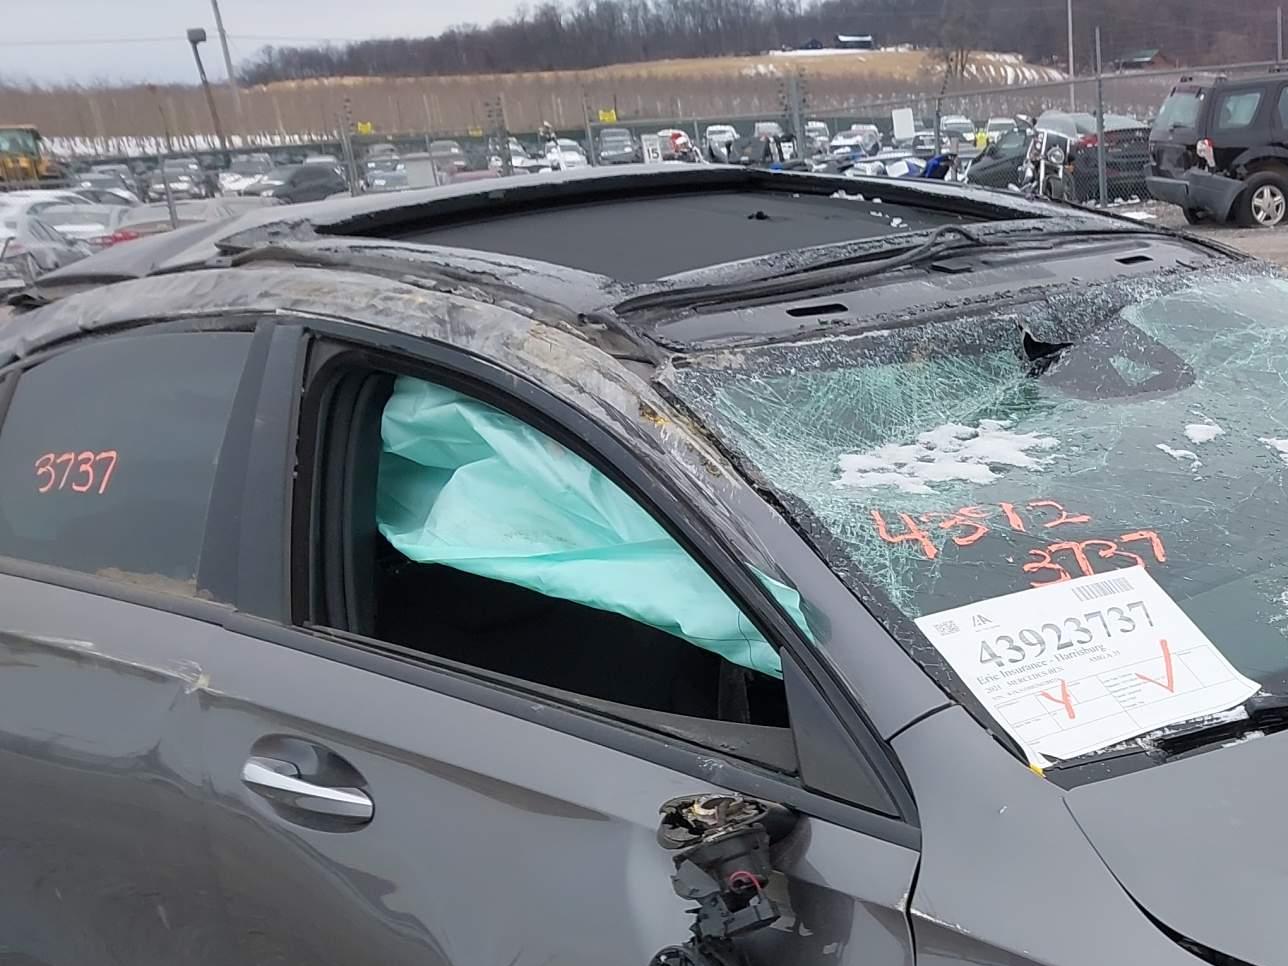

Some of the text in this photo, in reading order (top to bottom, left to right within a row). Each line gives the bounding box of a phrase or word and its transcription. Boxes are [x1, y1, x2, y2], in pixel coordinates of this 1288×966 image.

[35, 450, 117, 494] 3737
[1023, 531, 1167, 588] 3737
[978, 600, 1155, 668] 43923737
[999, 660, 1048, 678] Insurance
[1054, 644, 1106, 662] Harrisburg
